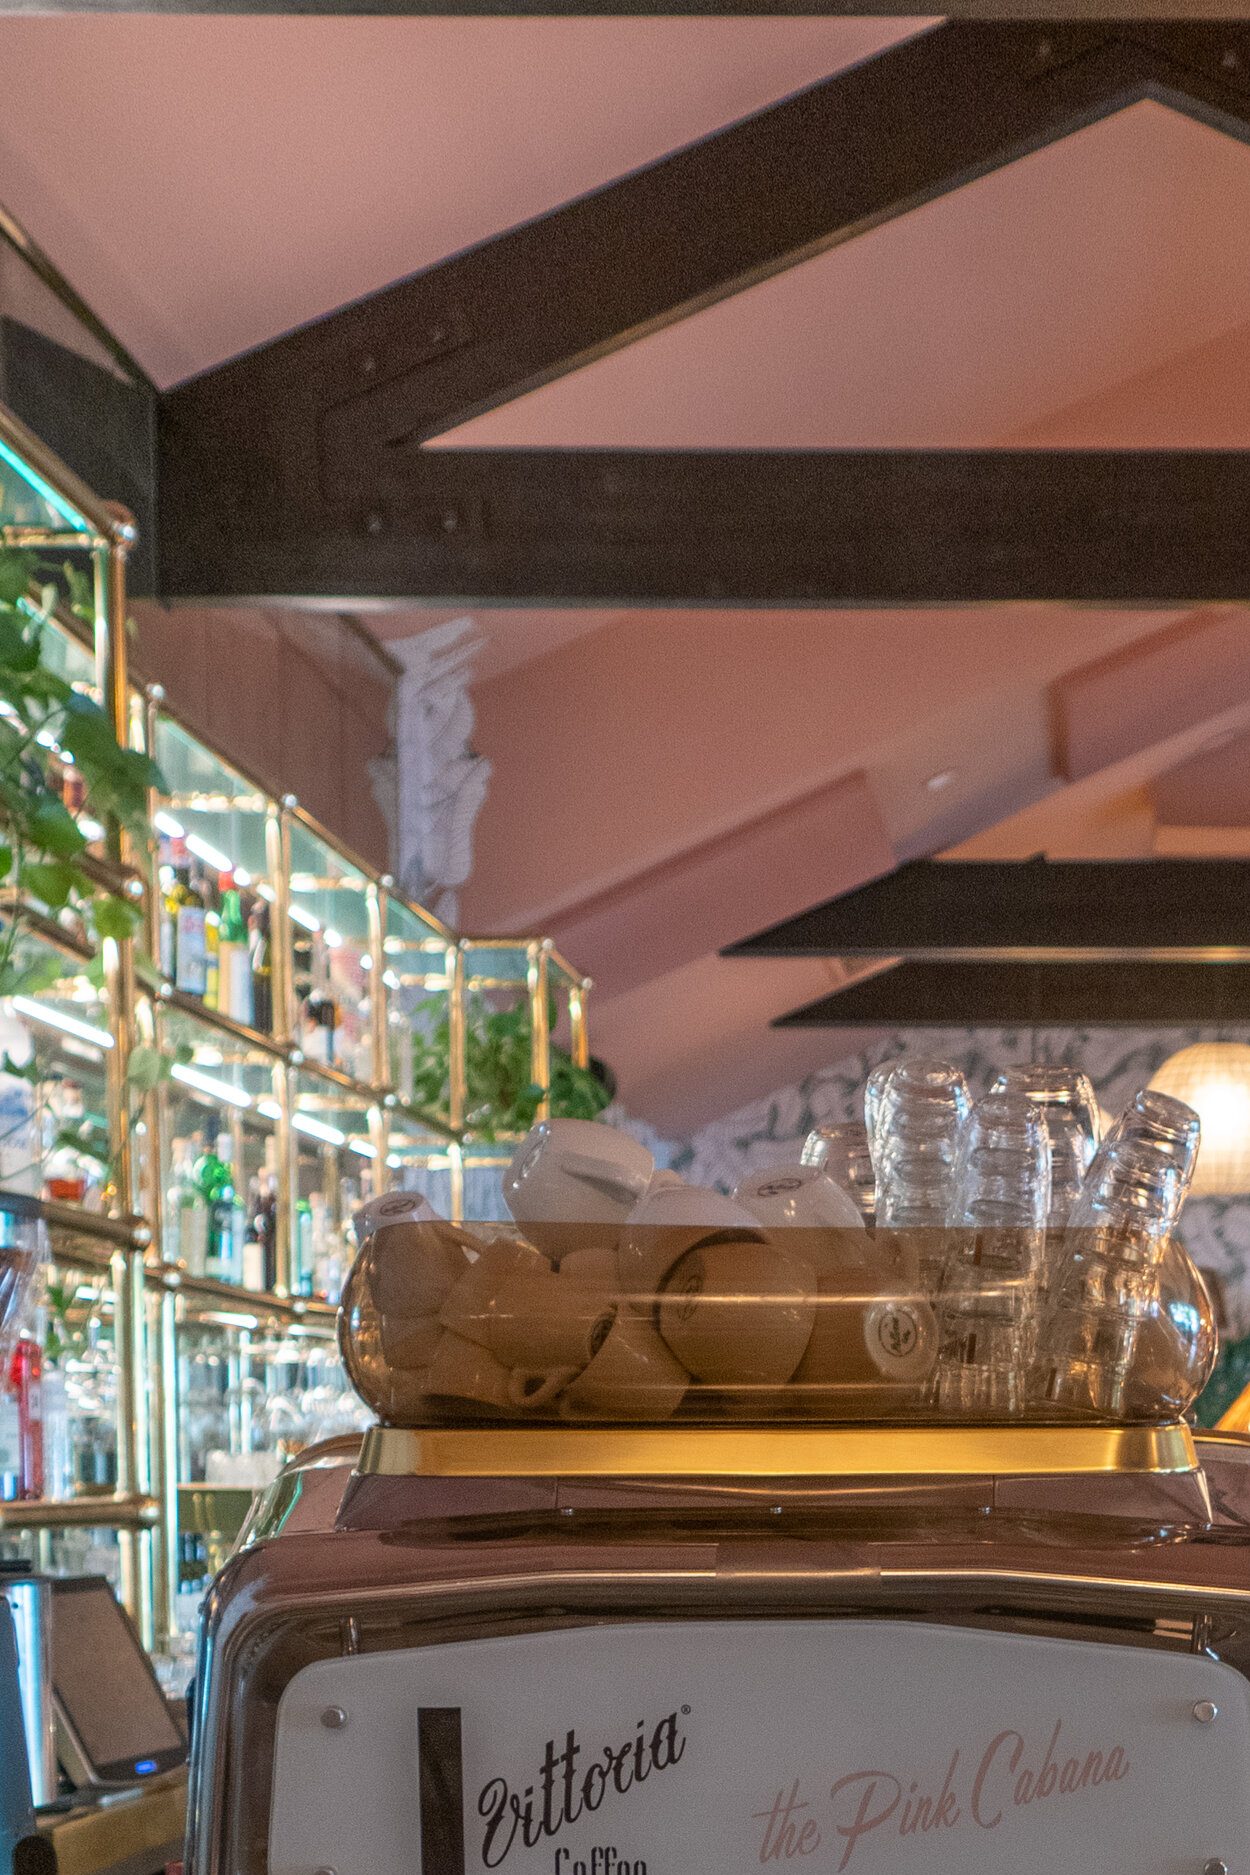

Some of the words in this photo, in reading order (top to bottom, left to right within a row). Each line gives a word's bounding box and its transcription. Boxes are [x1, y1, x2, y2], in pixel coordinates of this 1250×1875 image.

[751, 1777, 822, 1864] the
[830, 1748, 961, 1873] Pink
[970, 1718, 1131, 1830] Cabana
